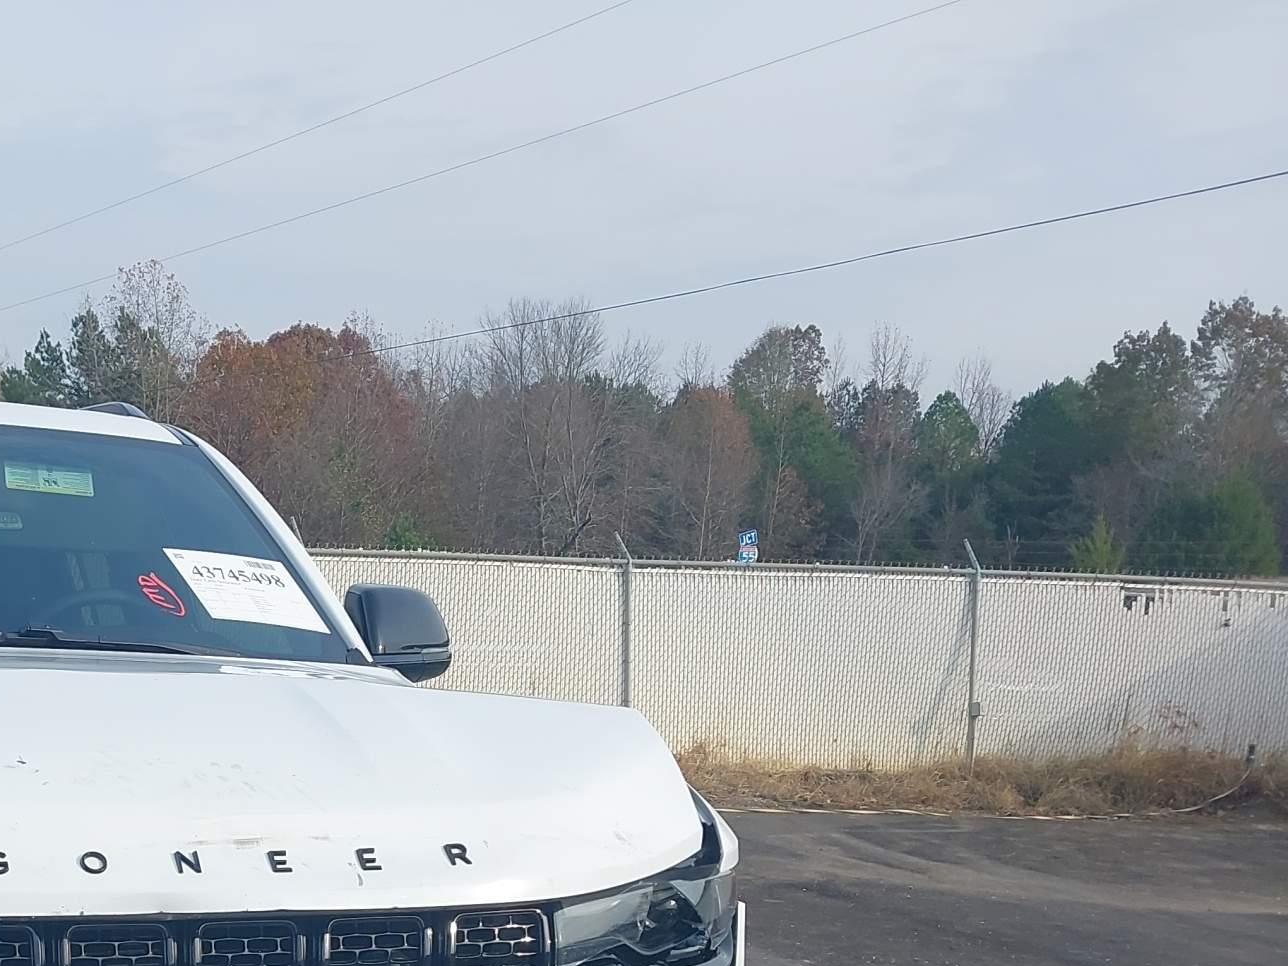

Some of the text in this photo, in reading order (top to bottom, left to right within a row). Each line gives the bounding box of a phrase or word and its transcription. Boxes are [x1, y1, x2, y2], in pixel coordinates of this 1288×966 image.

[741, 532, 756, 545] JCT
[742, 551, 755, 563] 55
[191, 565, 286, 588] 43745498
